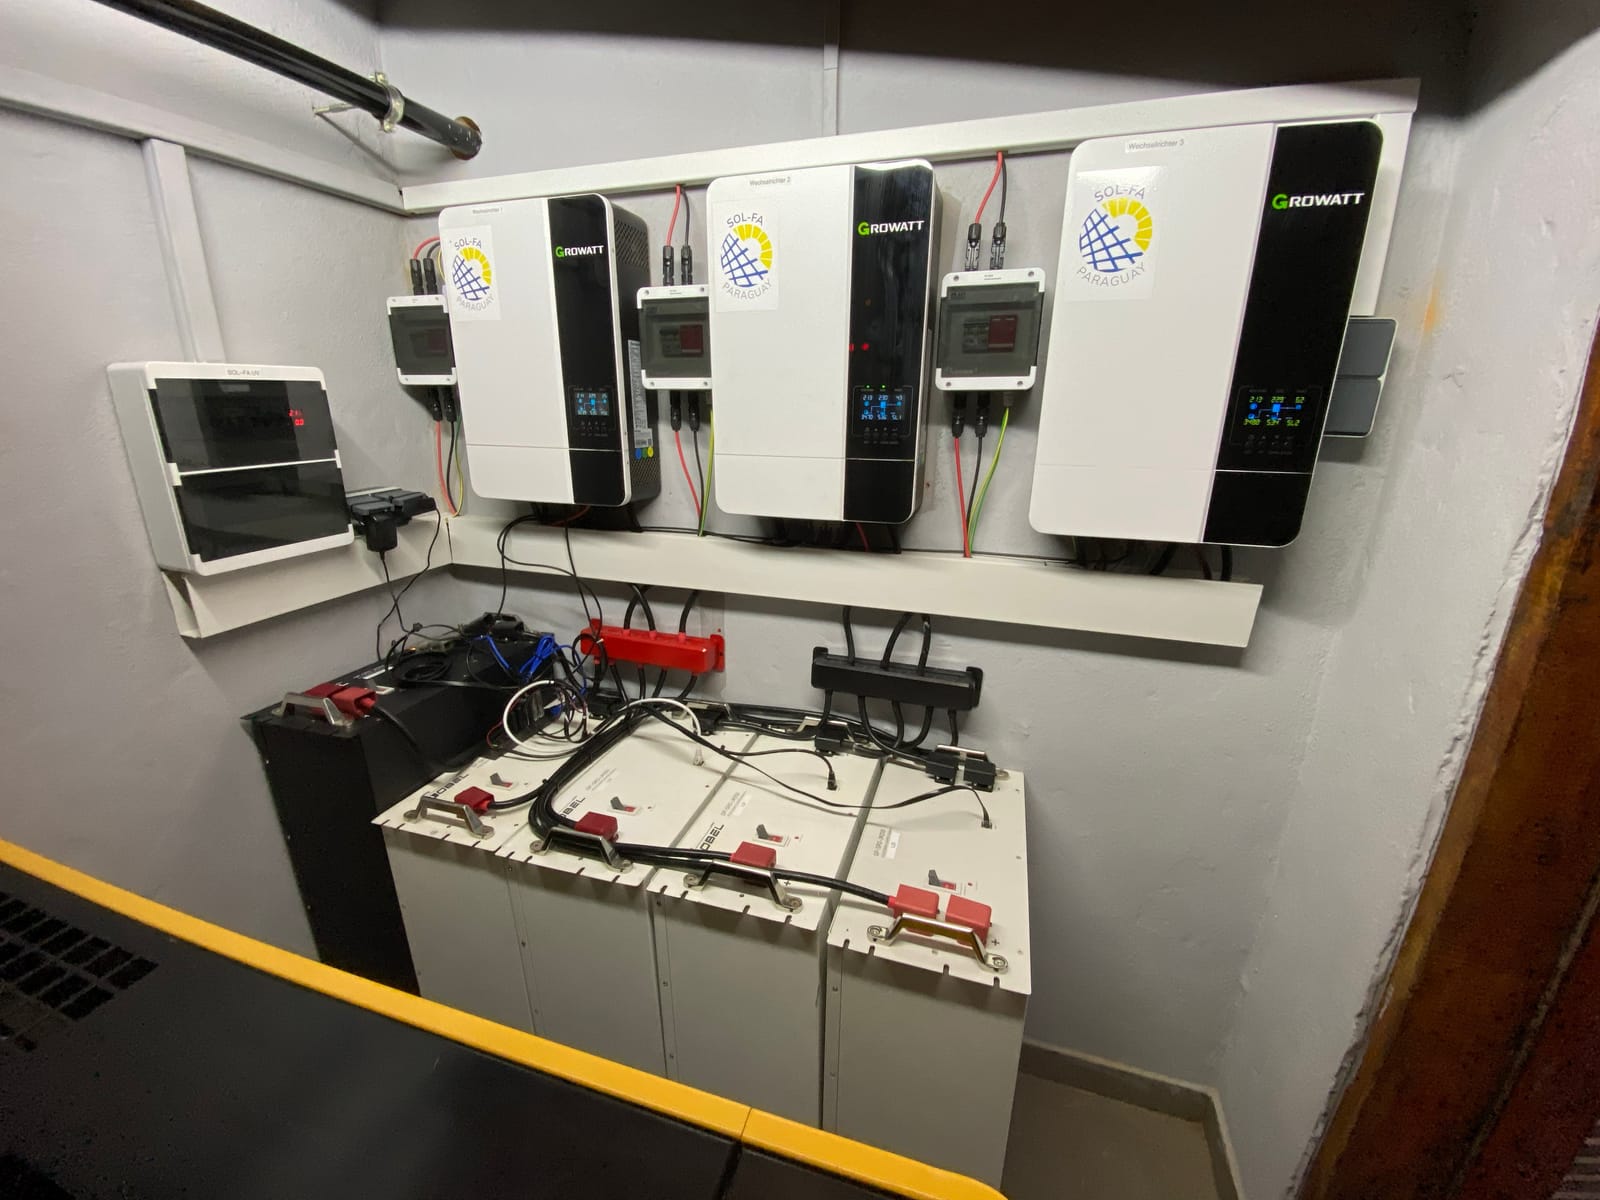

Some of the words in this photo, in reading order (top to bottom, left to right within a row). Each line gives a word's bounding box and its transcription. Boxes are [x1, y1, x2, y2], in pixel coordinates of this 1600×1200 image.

[1094, 185, 1146, 202] SOL-FA
[1272, 193, 1365, 210] GROWATT
[726, 213, 764, 228] SOL-FA
[857, 220, 925, 236] GROWATT
[454, 237, 483, 251] SOL-FA
[555, 245, 605, 258] GROWATT
[1076, 262, 1145, 287] PARAGUAY
[722, 279, 773, 301] PARAGUAY
[456, 294, 496, 312] PARAGUAY
[560, 797, 587, 818] BEL
[700, 824, 725, 851] OBEL
